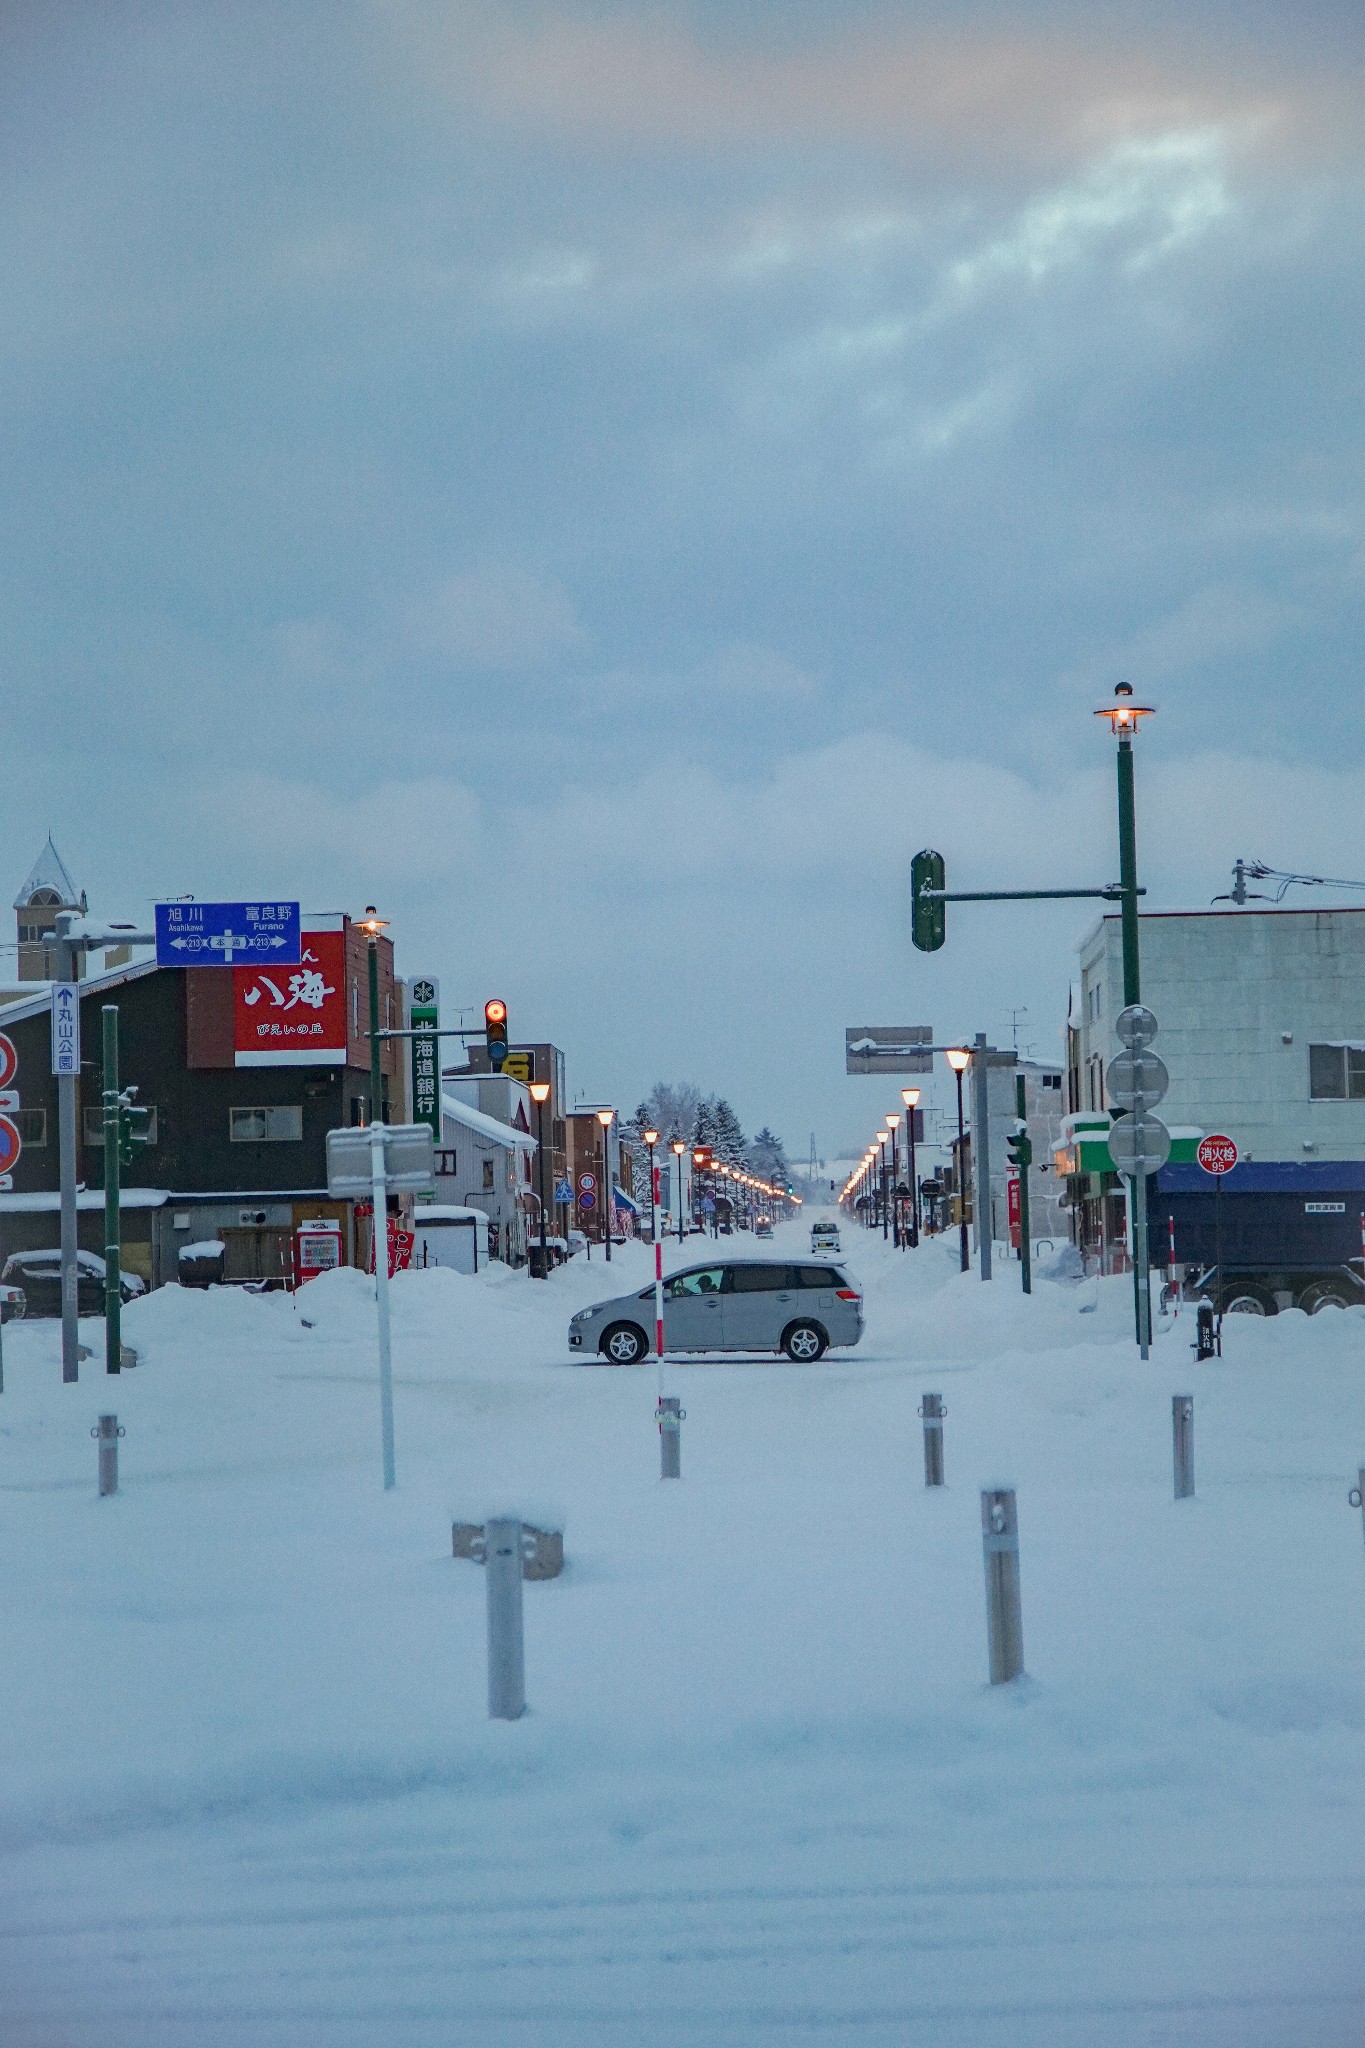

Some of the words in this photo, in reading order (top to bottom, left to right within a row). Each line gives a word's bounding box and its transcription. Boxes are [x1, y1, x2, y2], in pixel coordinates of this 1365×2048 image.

[168, 907, 203, 922] 旭川
[245, 905, 292, 921] 富良野
[168, 923, 204, 932] Asahikawa
[253, 922, 285, 931] Furano
[188, 938, 200, 948] 213
[256, 937, 268, 947] 213
[257, 1023, 324, 1036] びえいの丘
[58, 1008, 74, 1070] 丸山公園
[1200, 1147, 1235, 1161] 消火栓
[1212, 1162, 1225, 1172] 95
[583, 1178, 593, 1187] 40
